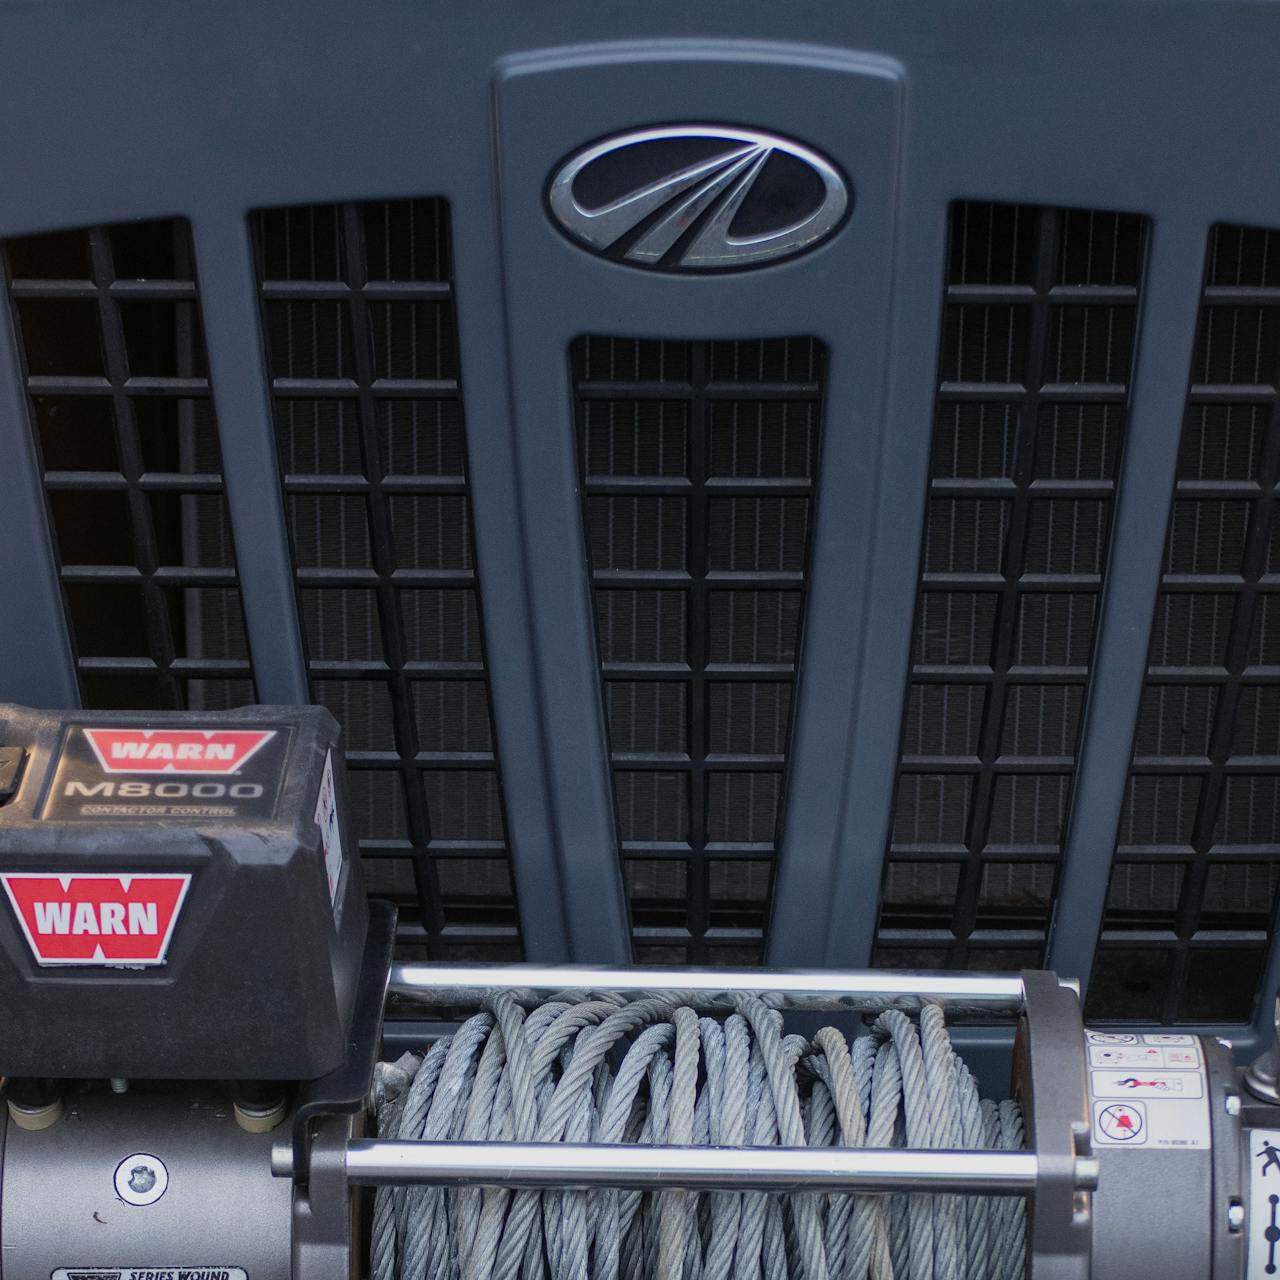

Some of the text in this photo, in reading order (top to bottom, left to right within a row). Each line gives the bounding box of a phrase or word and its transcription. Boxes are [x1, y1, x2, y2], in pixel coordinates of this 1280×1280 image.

[111, 742, 236, 761] WARN
[64, 781, 264, 798] M8000
[81, 805, 237, 815] CONTACTOR CONTROL
[33, 901, 159, 935] WARN
